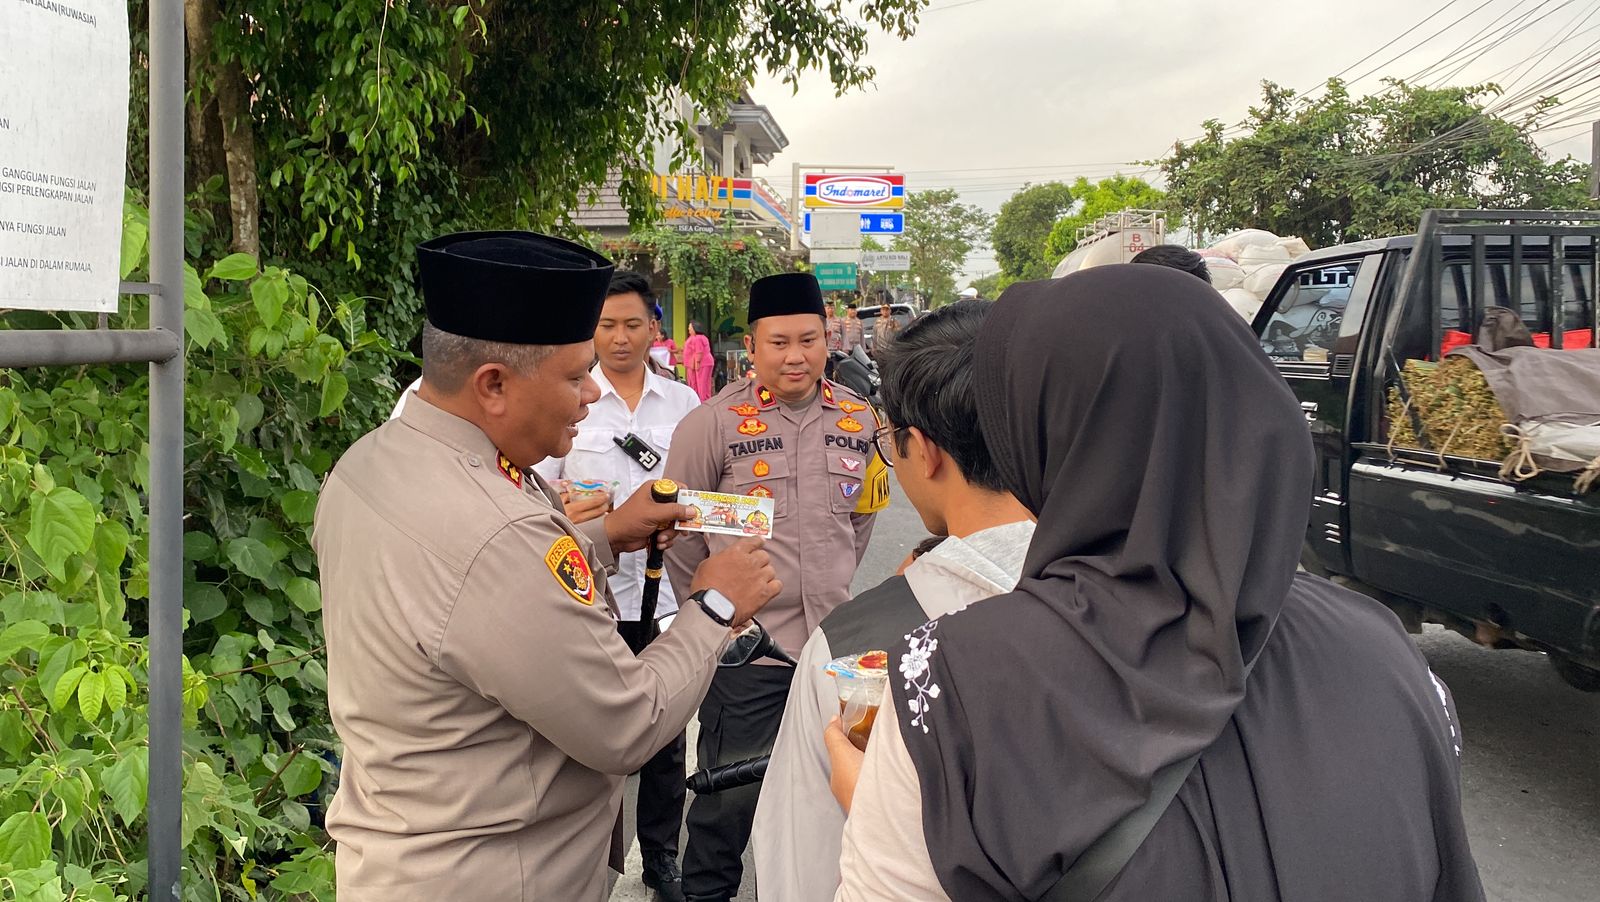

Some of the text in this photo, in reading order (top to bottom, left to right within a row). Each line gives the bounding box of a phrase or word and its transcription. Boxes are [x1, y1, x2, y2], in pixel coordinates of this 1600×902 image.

[2, 167, 97, 192] GANGGUAN FUNGSI JALAN
[16, 184, 73, 202] PERLENGKAPAN
[74, 192, 94, 205] JALAN
[823, 184, 886, 198] Indomaret
[16, 222, 45, 235] FUNGSI
[45, 225, 67, 237] JALAN
[694, 226, 714, 234] Group
[1132, 233, 1141, 242] B
[5, 256, 29, 269] JALAN
[30, 258, 38, 269] DI
[39, 259, 64, 270] DALAM
[729, 437, 783, 457] TAUFAN
[824, 434, 869, 455] POLRI
